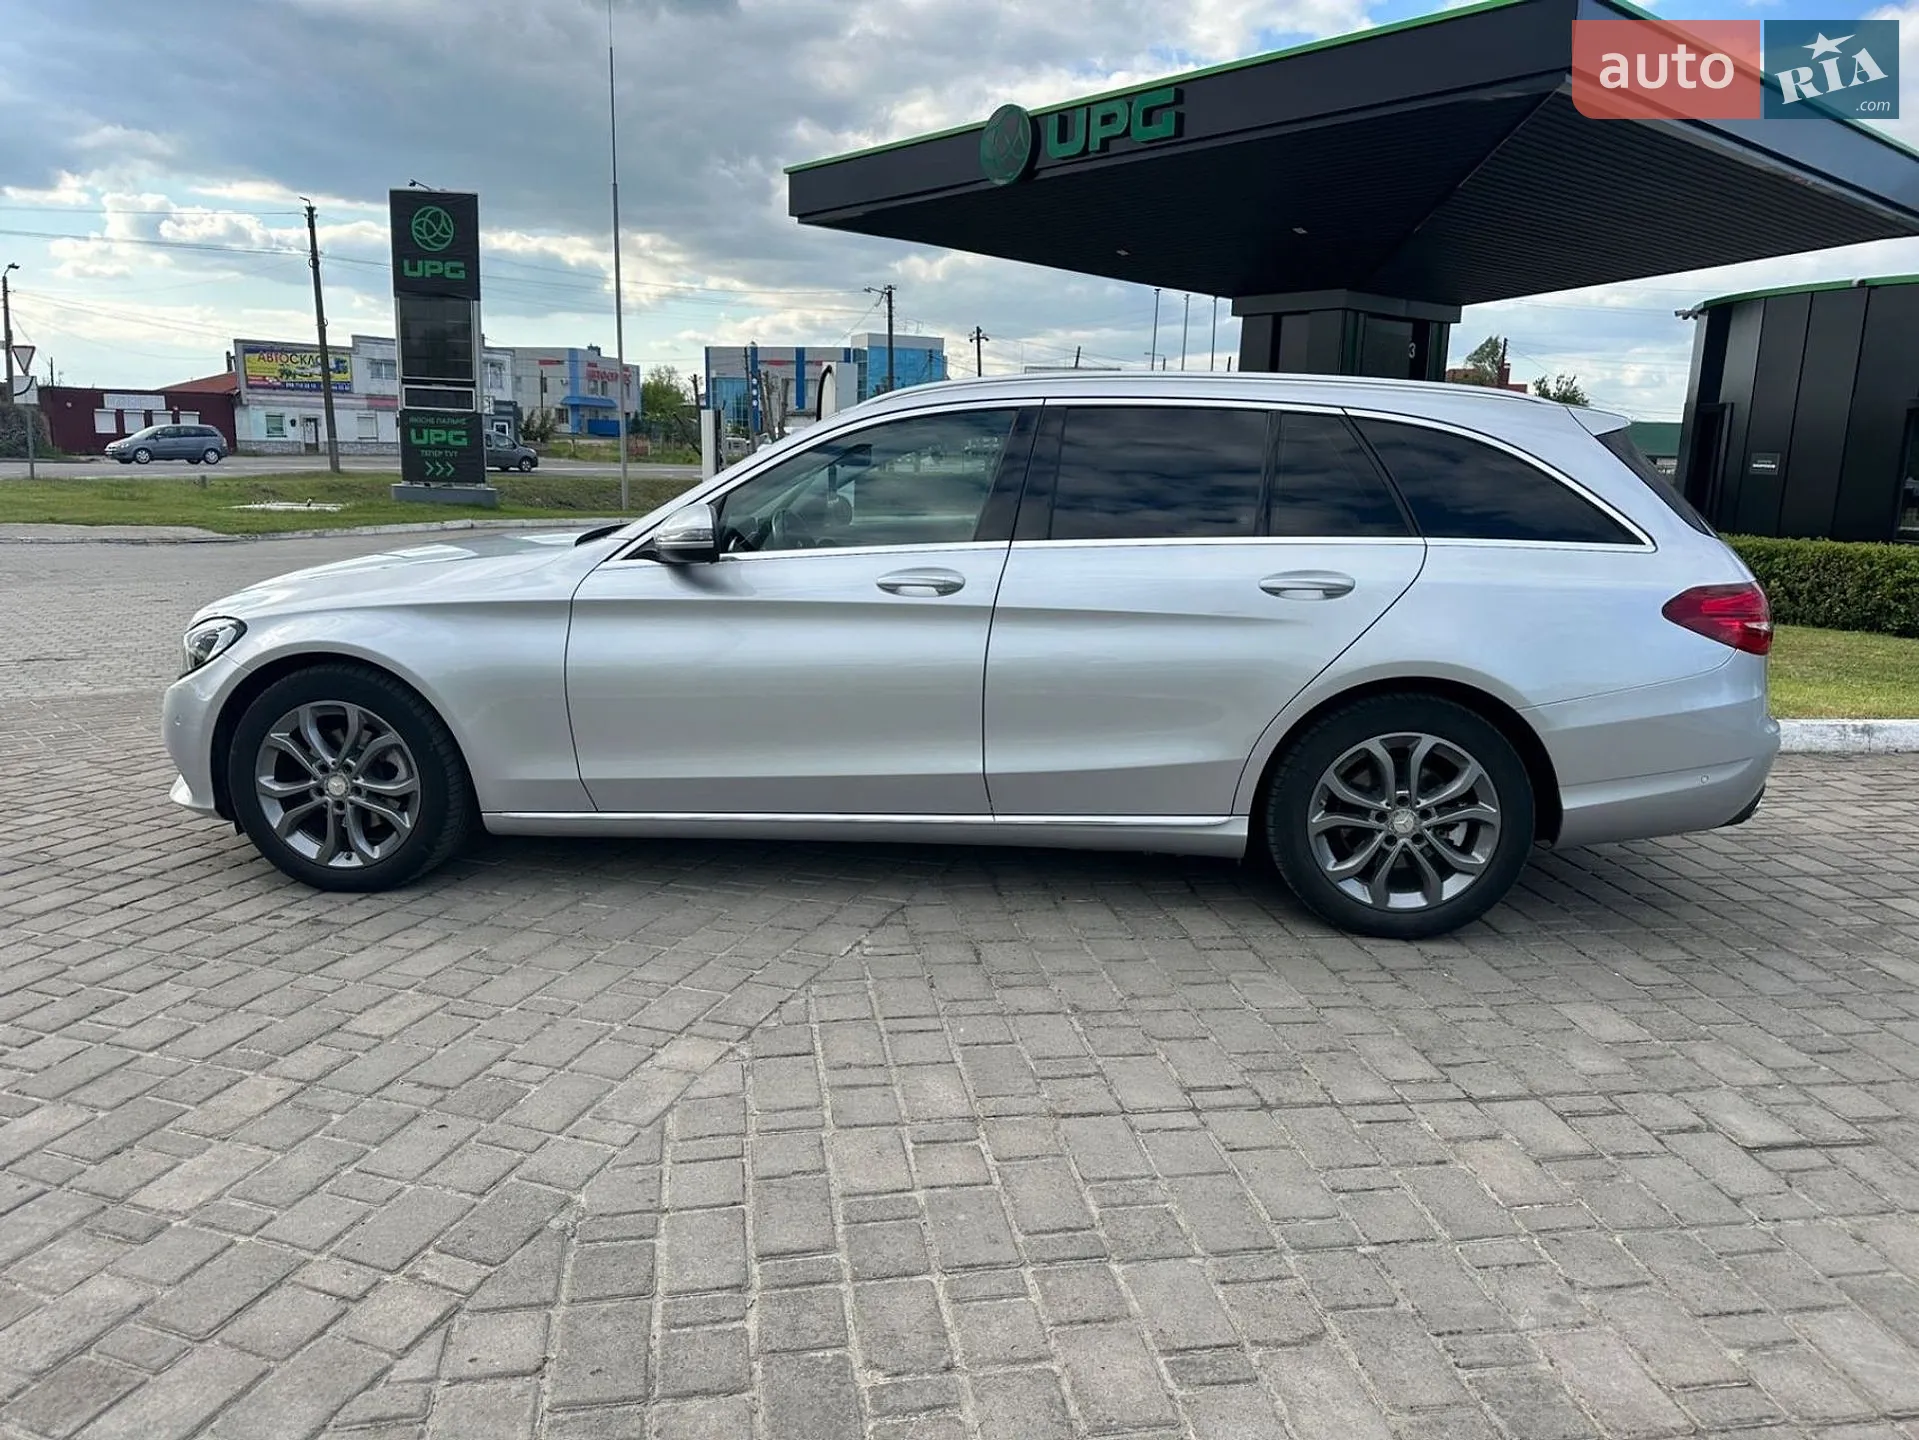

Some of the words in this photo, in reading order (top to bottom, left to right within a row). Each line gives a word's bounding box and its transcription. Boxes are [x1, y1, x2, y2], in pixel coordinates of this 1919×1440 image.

[1047, 87, 1177, 160] UPG
[403, 259, 466, 279] UPG
[1408, 342, 1416, 359] 3
[410, 428, 468, 446] UPG
